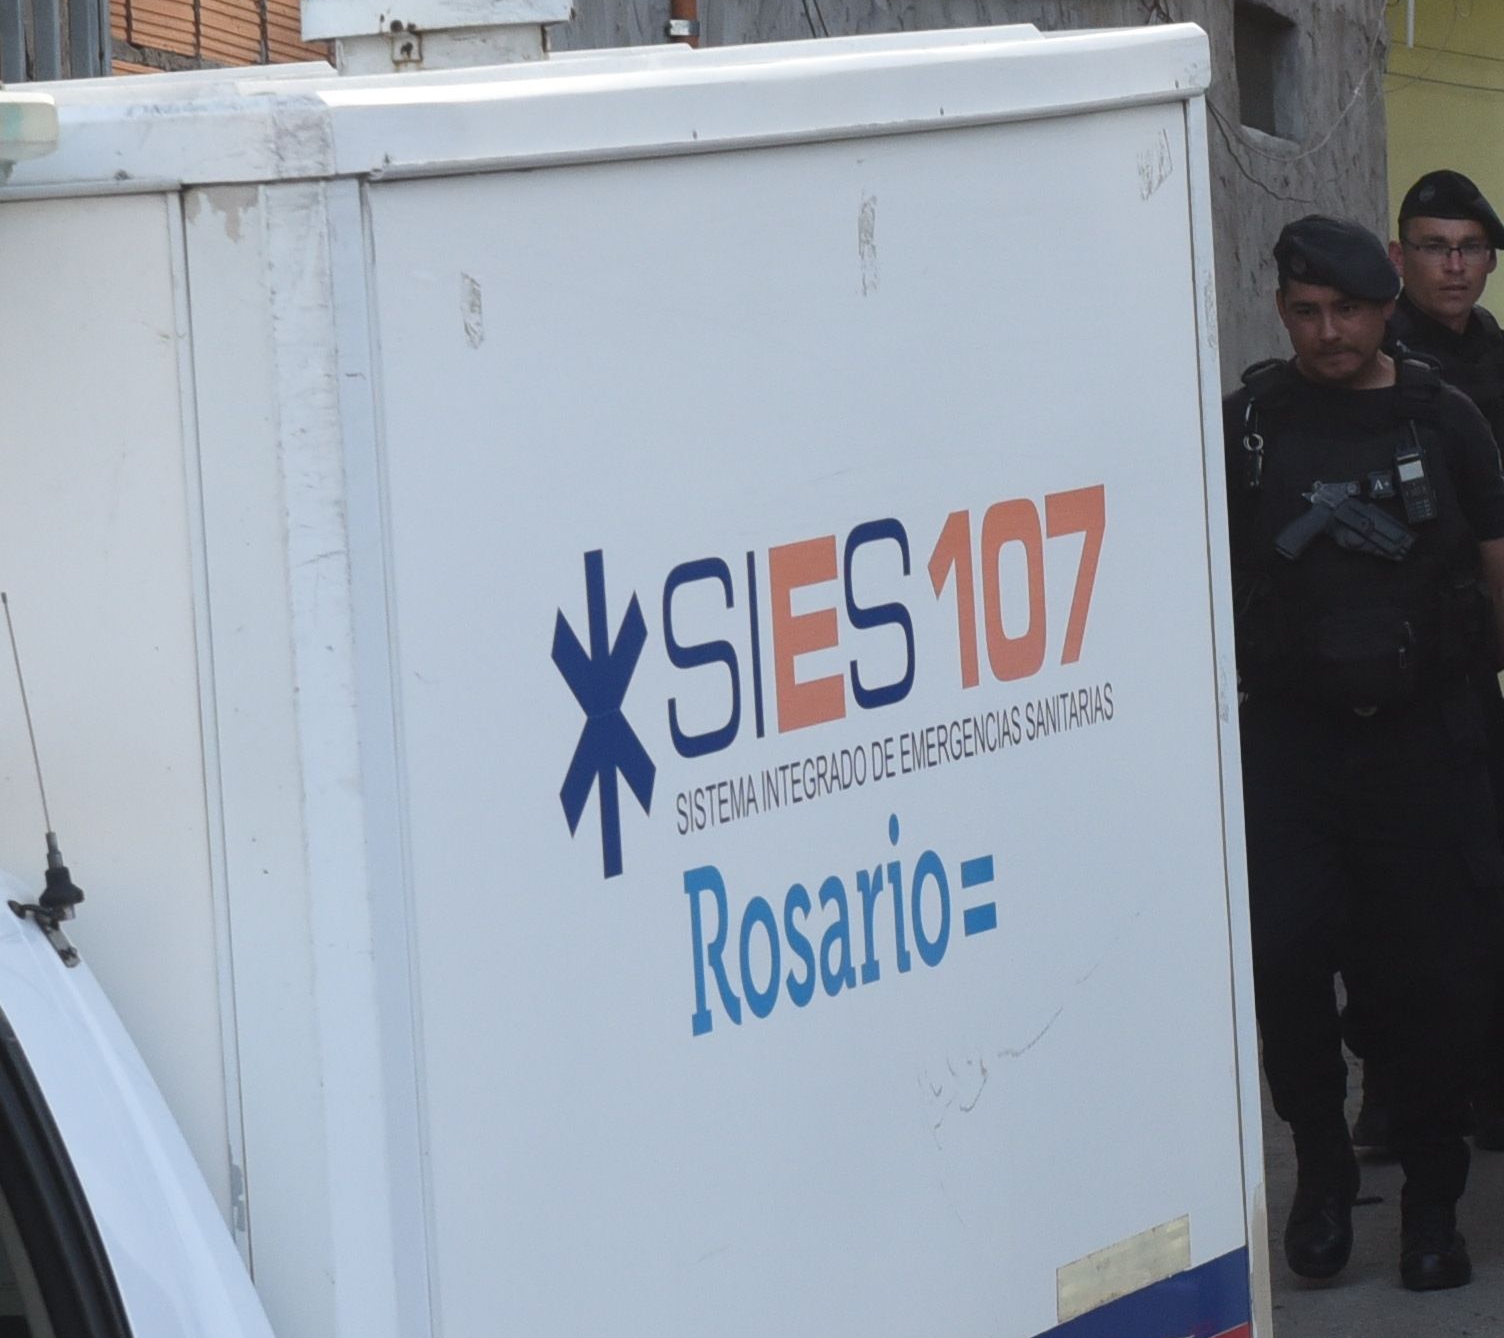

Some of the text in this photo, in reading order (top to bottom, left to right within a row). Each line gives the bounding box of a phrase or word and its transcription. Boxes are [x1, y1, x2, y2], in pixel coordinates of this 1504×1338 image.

[662, 484, 1107, 759] SIES 107
[676, 682, 1114, 835] SISTEMA INTEGRADO DE EMERGENCIAS SANITARIAS
